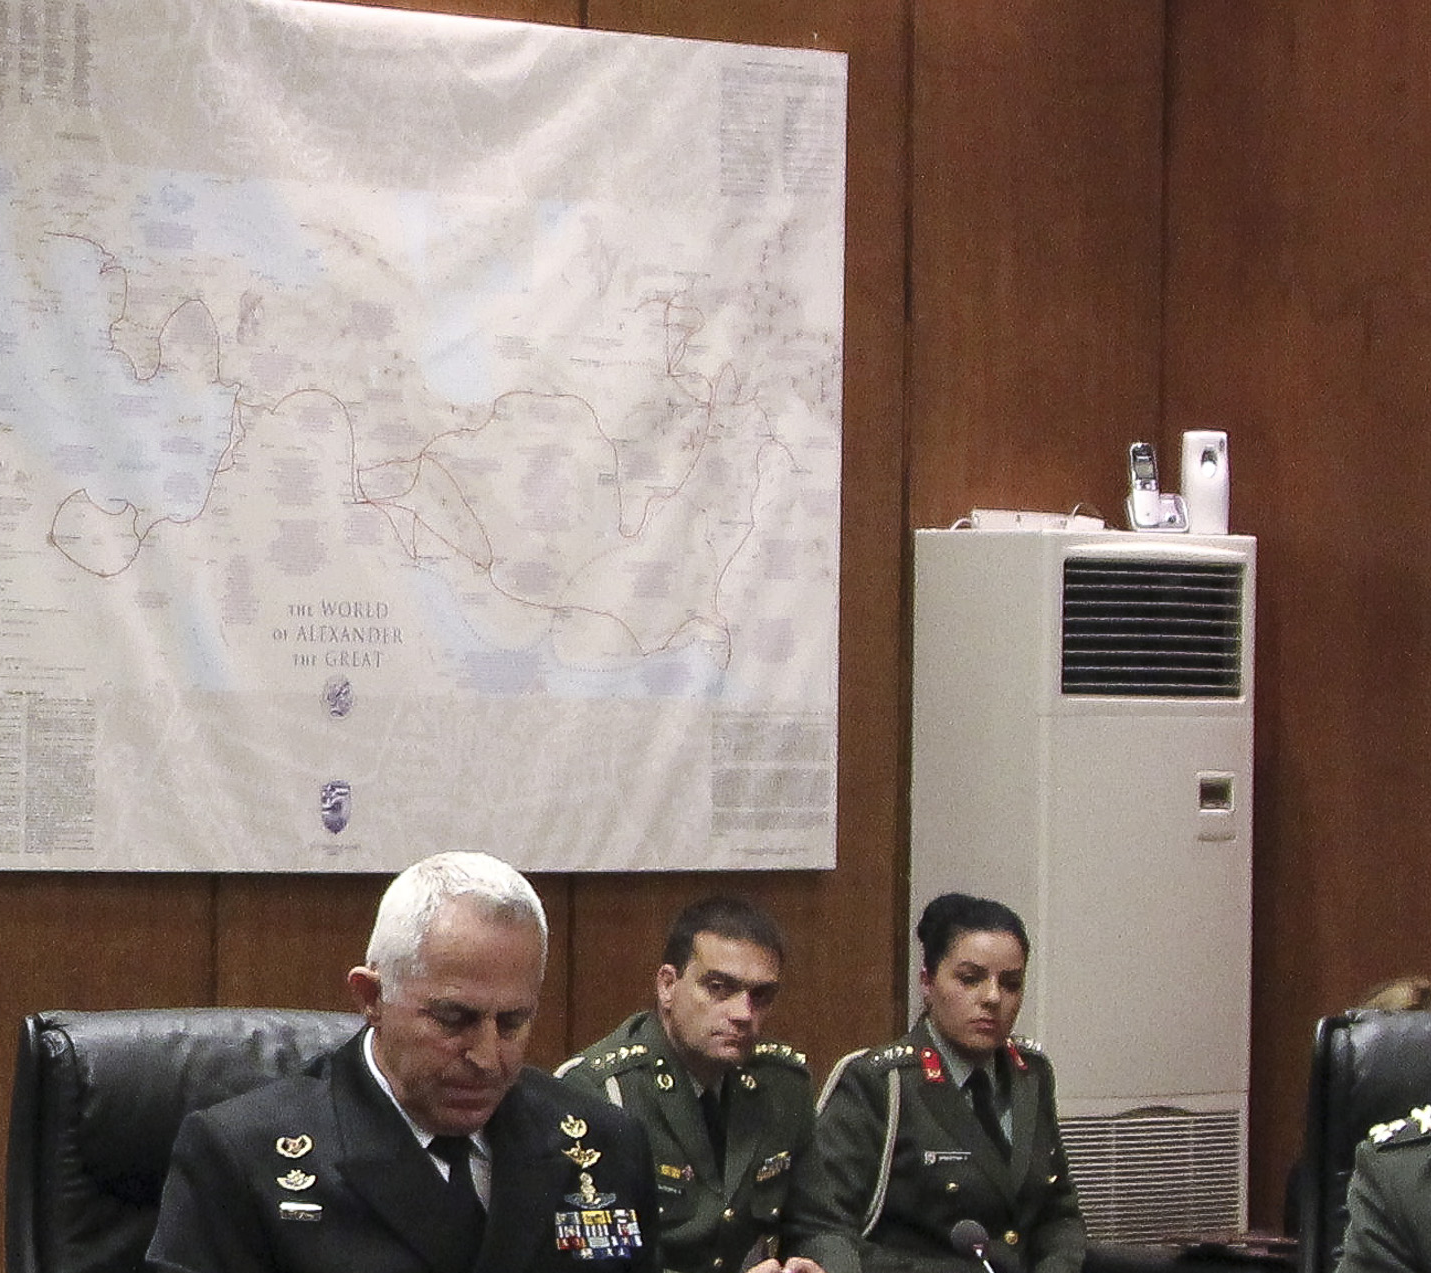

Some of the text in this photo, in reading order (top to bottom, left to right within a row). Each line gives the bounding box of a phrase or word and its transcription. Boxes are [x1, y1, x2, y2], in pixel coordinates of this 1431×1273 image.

[321, 600, 390, 619] WORLD
[295, 625, 404, 645] ALEXANDER
[324, 650, 384, 669] GREAT
